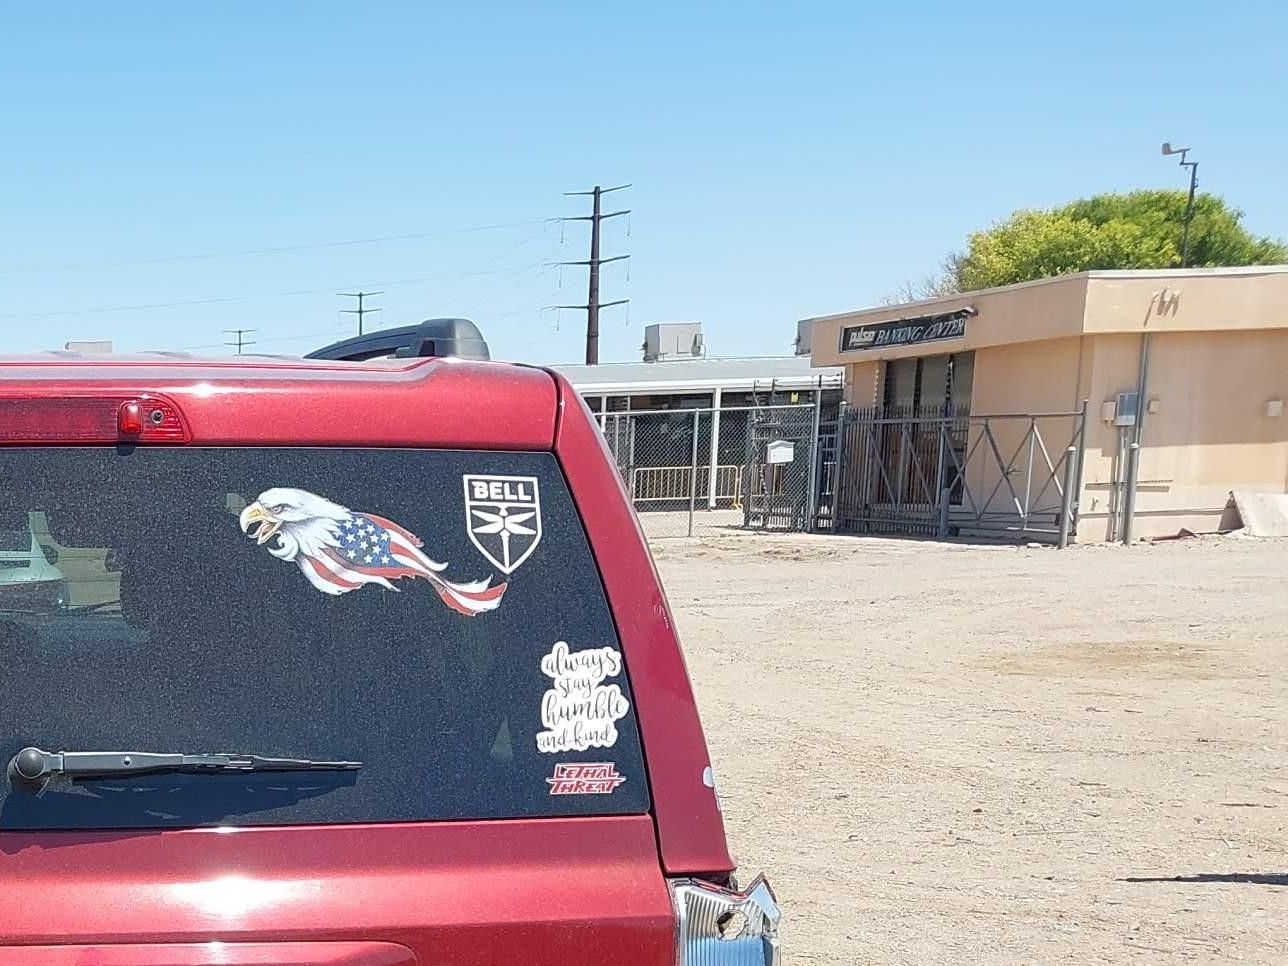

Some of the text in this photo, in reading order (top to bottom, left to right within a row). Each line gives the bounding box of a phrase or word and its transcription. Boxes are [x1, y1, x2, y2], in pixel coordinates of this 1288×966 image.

[875, 326, 924, 345] BANKING
[923, 319, 964, 340] CENTER
[471, 481, 532, 501] BELL
[546, 646, 616, 677] always
[559, 676, 592, 698] stay
[546, 688, 625, 726] humble
